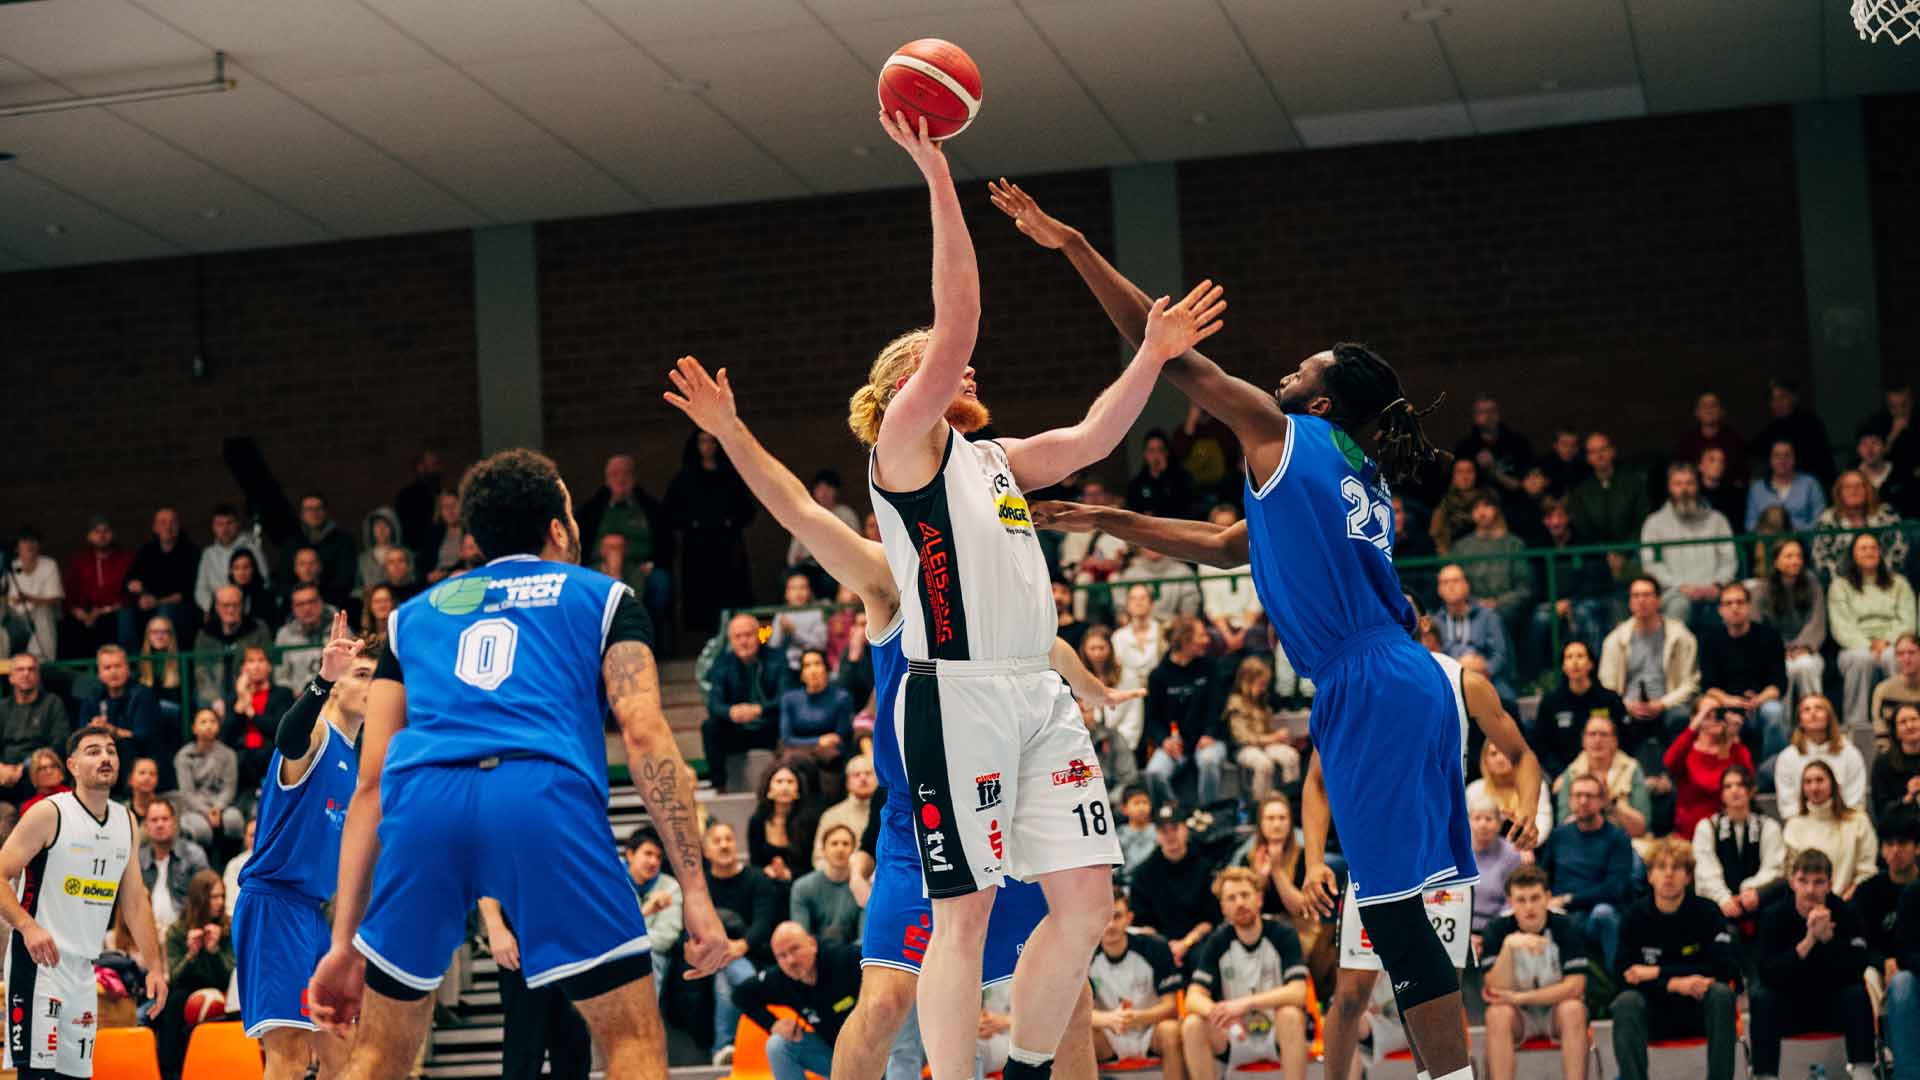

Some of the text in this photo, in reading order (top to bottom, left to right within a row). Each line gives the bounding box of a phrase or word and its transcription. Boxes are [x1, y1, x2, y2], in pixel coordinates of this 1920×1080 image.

[507, 583, 563, 600] TECH
[454, 617, 518, 691] 0
[1072, 800, 1107, 836] 18
[926, 831, 953, 872] tvi
[93, 858, 106, 876] 11
[1432, 916, 1456, 943] 23
[78, 1038, 94, 1059] 11
